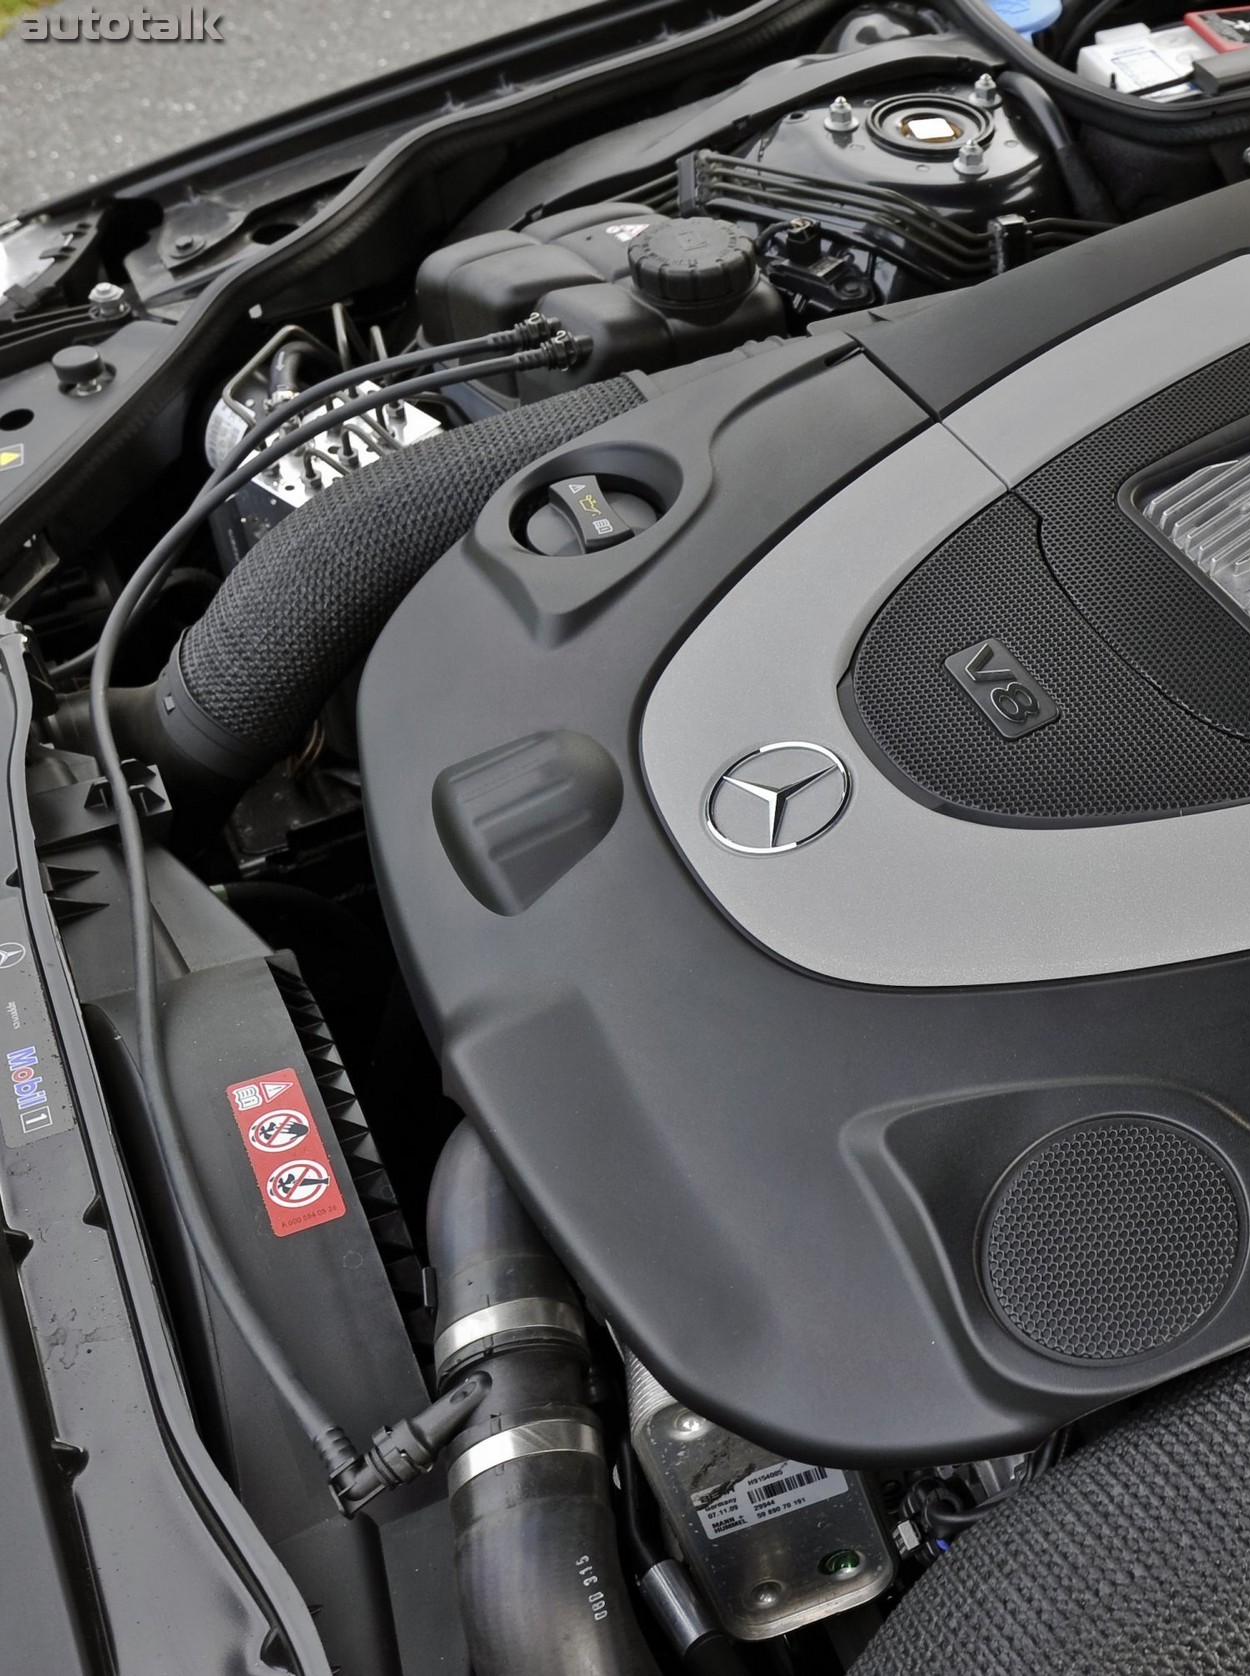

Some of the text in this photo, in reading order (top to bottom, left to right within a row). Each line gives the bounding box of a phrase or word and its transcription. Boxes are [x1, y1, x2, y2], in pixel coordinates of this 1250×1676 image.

[964, 643, 1040, 724] V8
[6, 1046, 48, 1110] Mobil
[711, 1516, 736, 1529] MANN
[714, 1518, 749, 1534] HUMMEL
